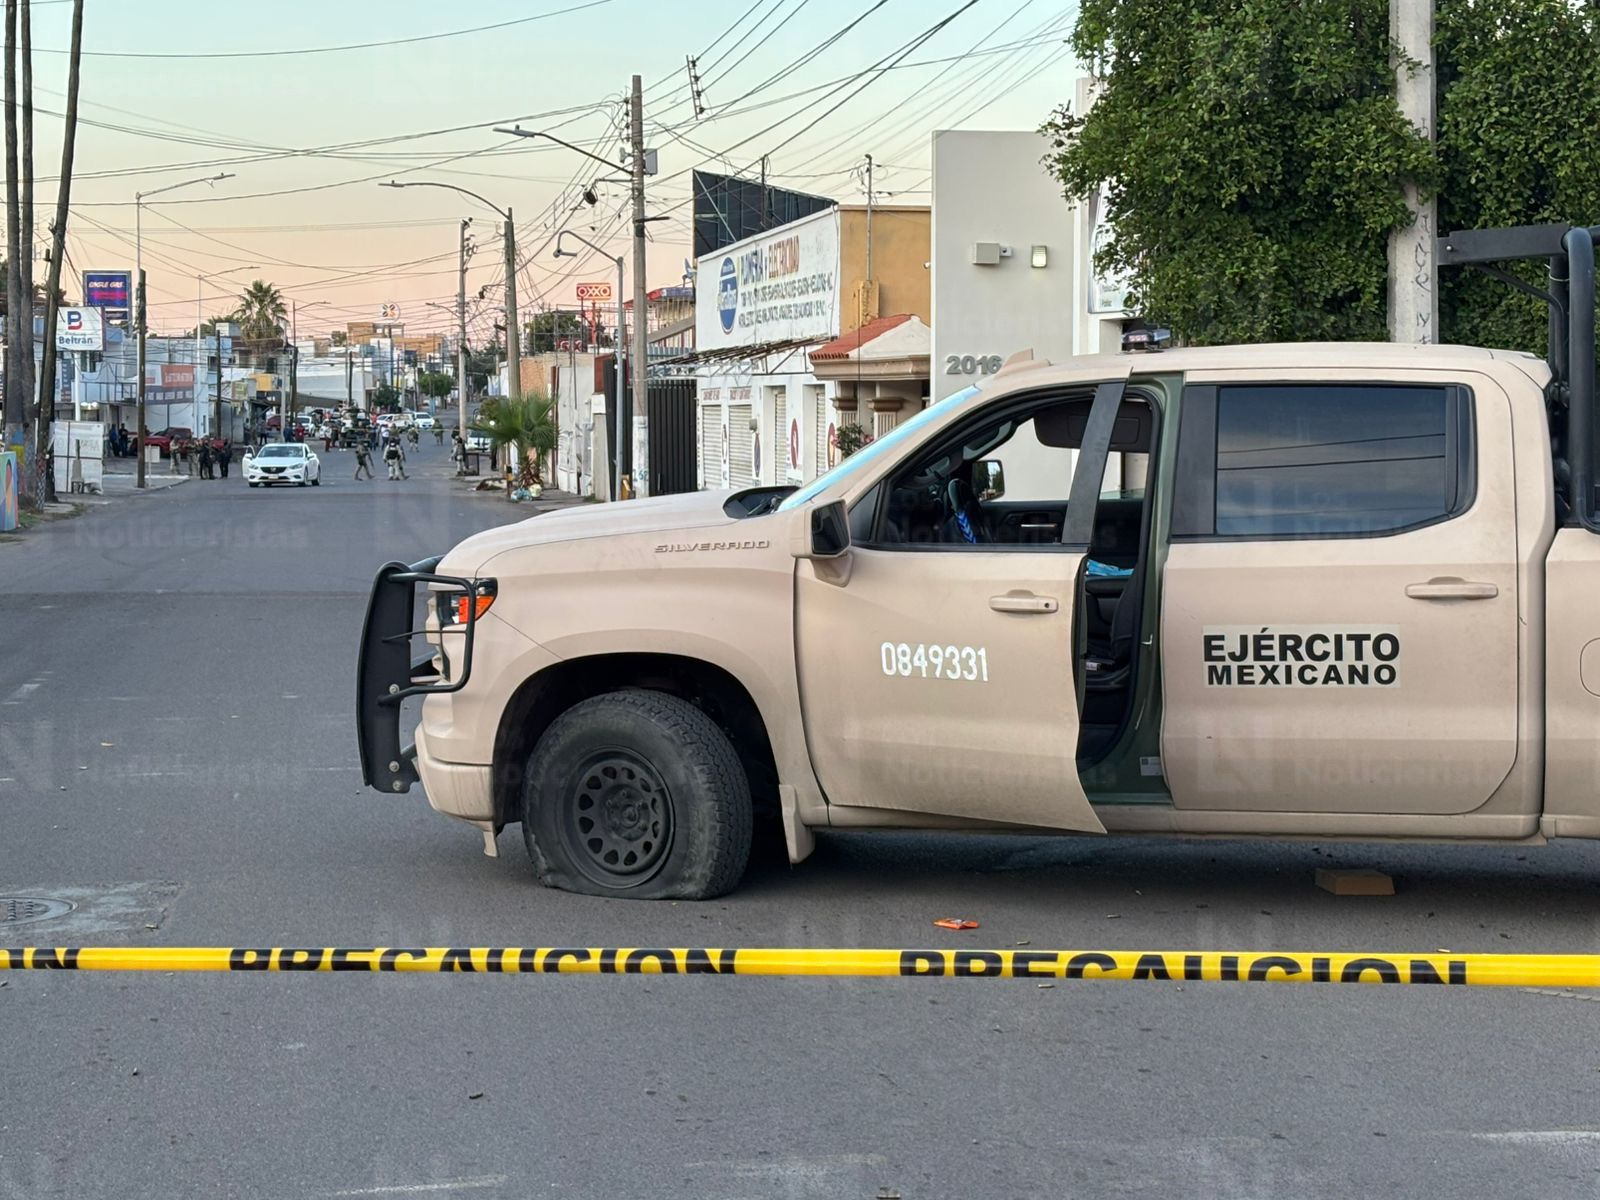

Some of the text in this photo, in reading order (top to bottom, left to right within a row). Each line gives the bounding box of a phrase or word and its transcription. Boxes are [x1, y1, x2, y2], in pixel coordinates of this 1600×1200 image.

[577, 286, 611, 298] OXXO
[58, 335, 93, 345] Beltrán
[946, 355, 1002, 375] 2016
[655, 540, 770, 553] SILVERADO
[1203, 627, 1400, 662] EJÉRCITO
[880, 641, 989, 682] 0849331
[1207, 664, 1397, 685] MEXICANO
